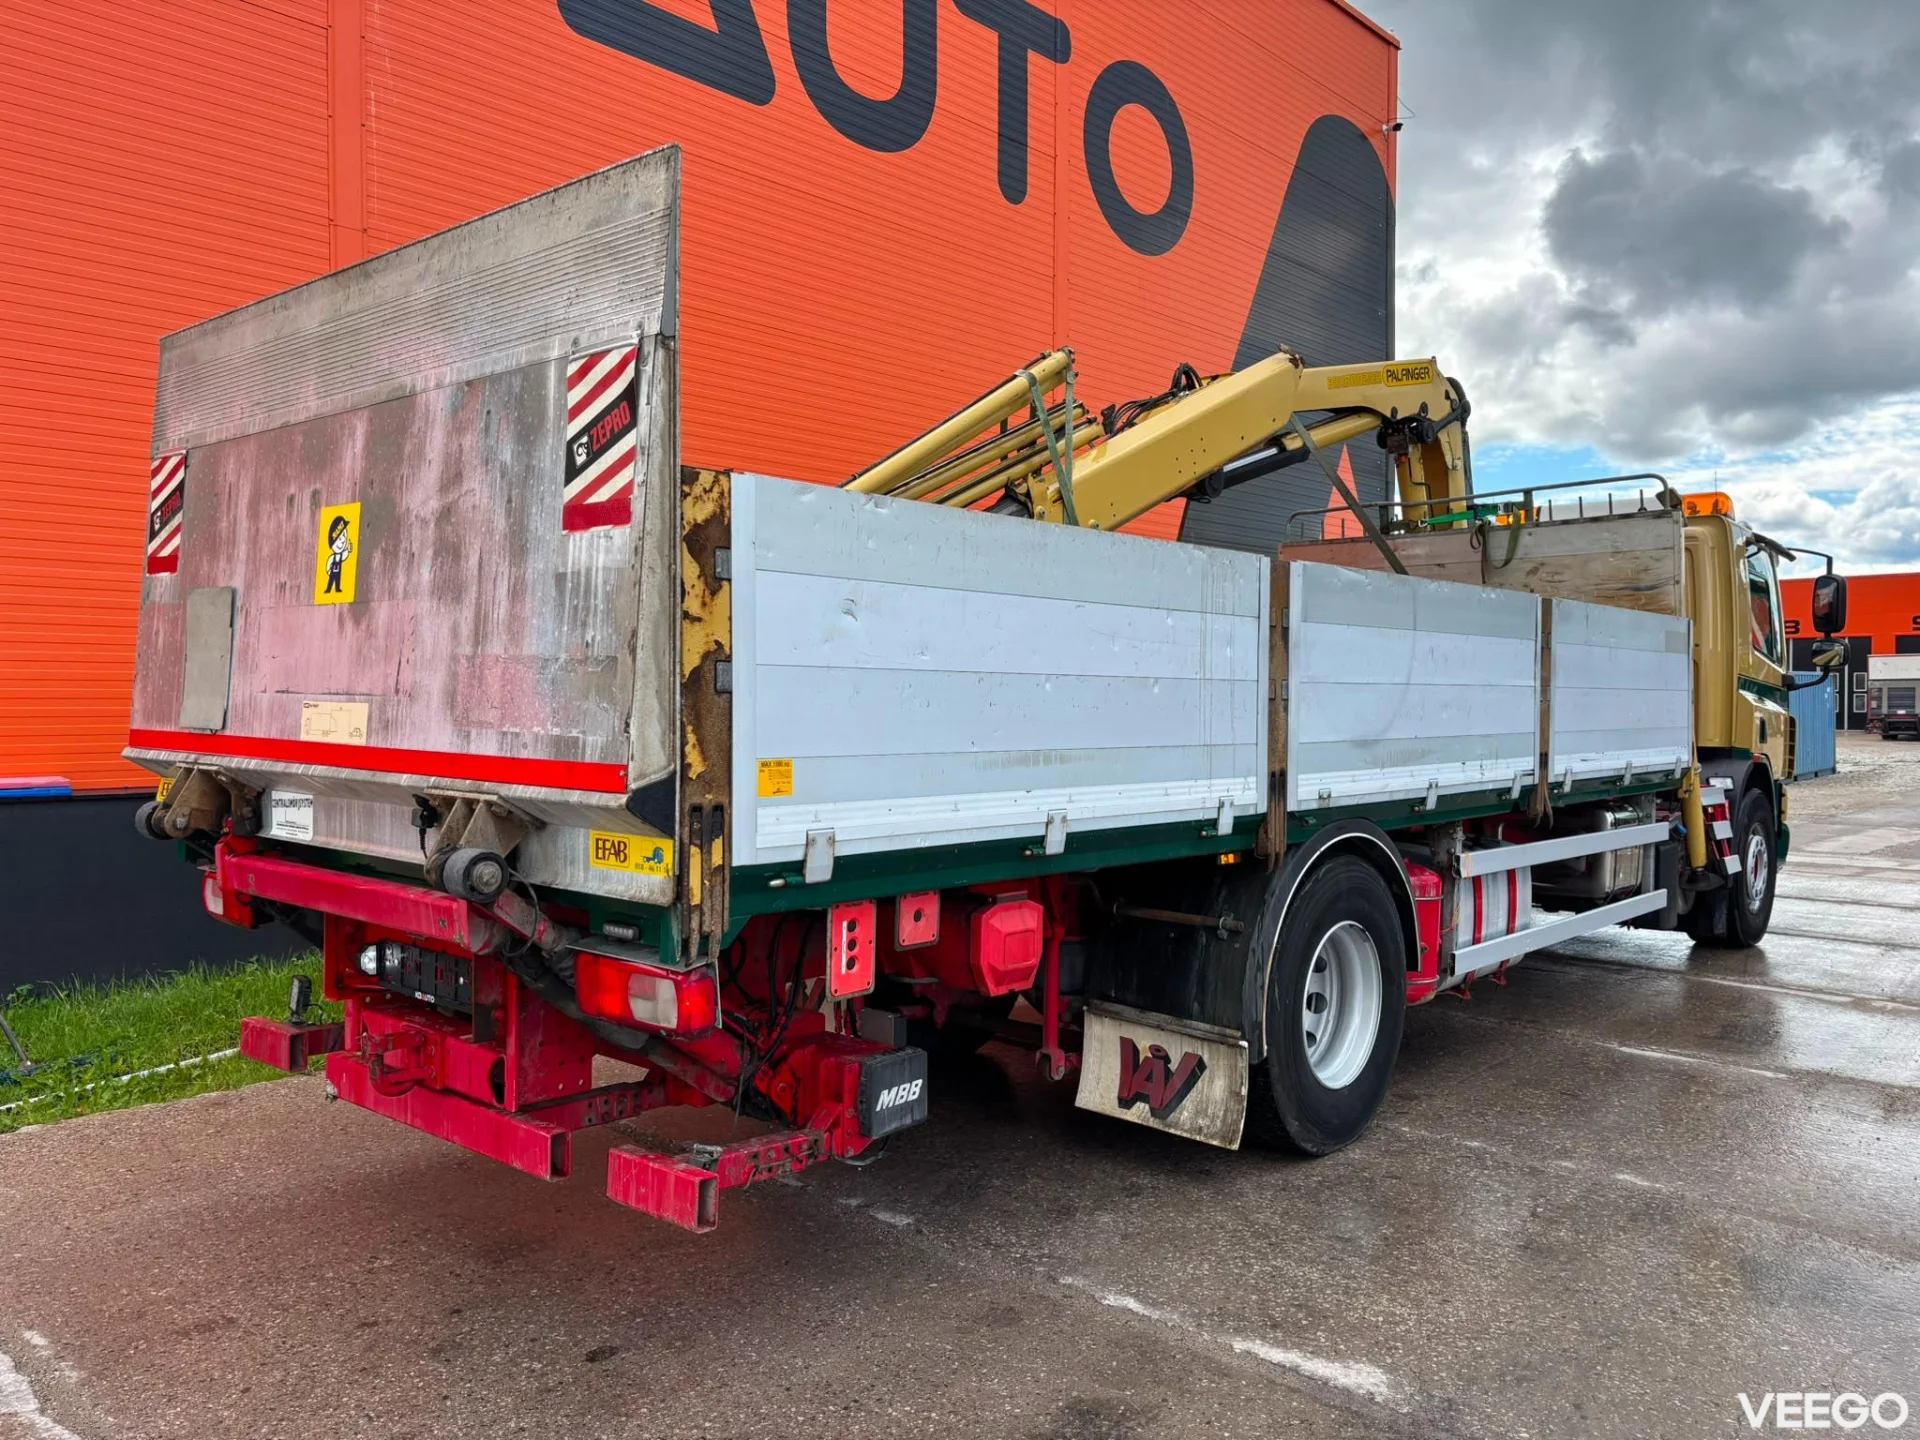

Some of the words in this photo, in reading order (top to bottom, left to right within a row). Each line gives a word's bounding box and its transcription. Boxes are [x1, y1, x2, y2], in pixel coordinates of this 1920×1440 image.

[1385, 366, 1430, 383] PALFINGER
[589, 400, 631, 452] ZEPRO
[595, 837, 628, 863] EFAB
[875, 1078, 923, 1112] MBB
